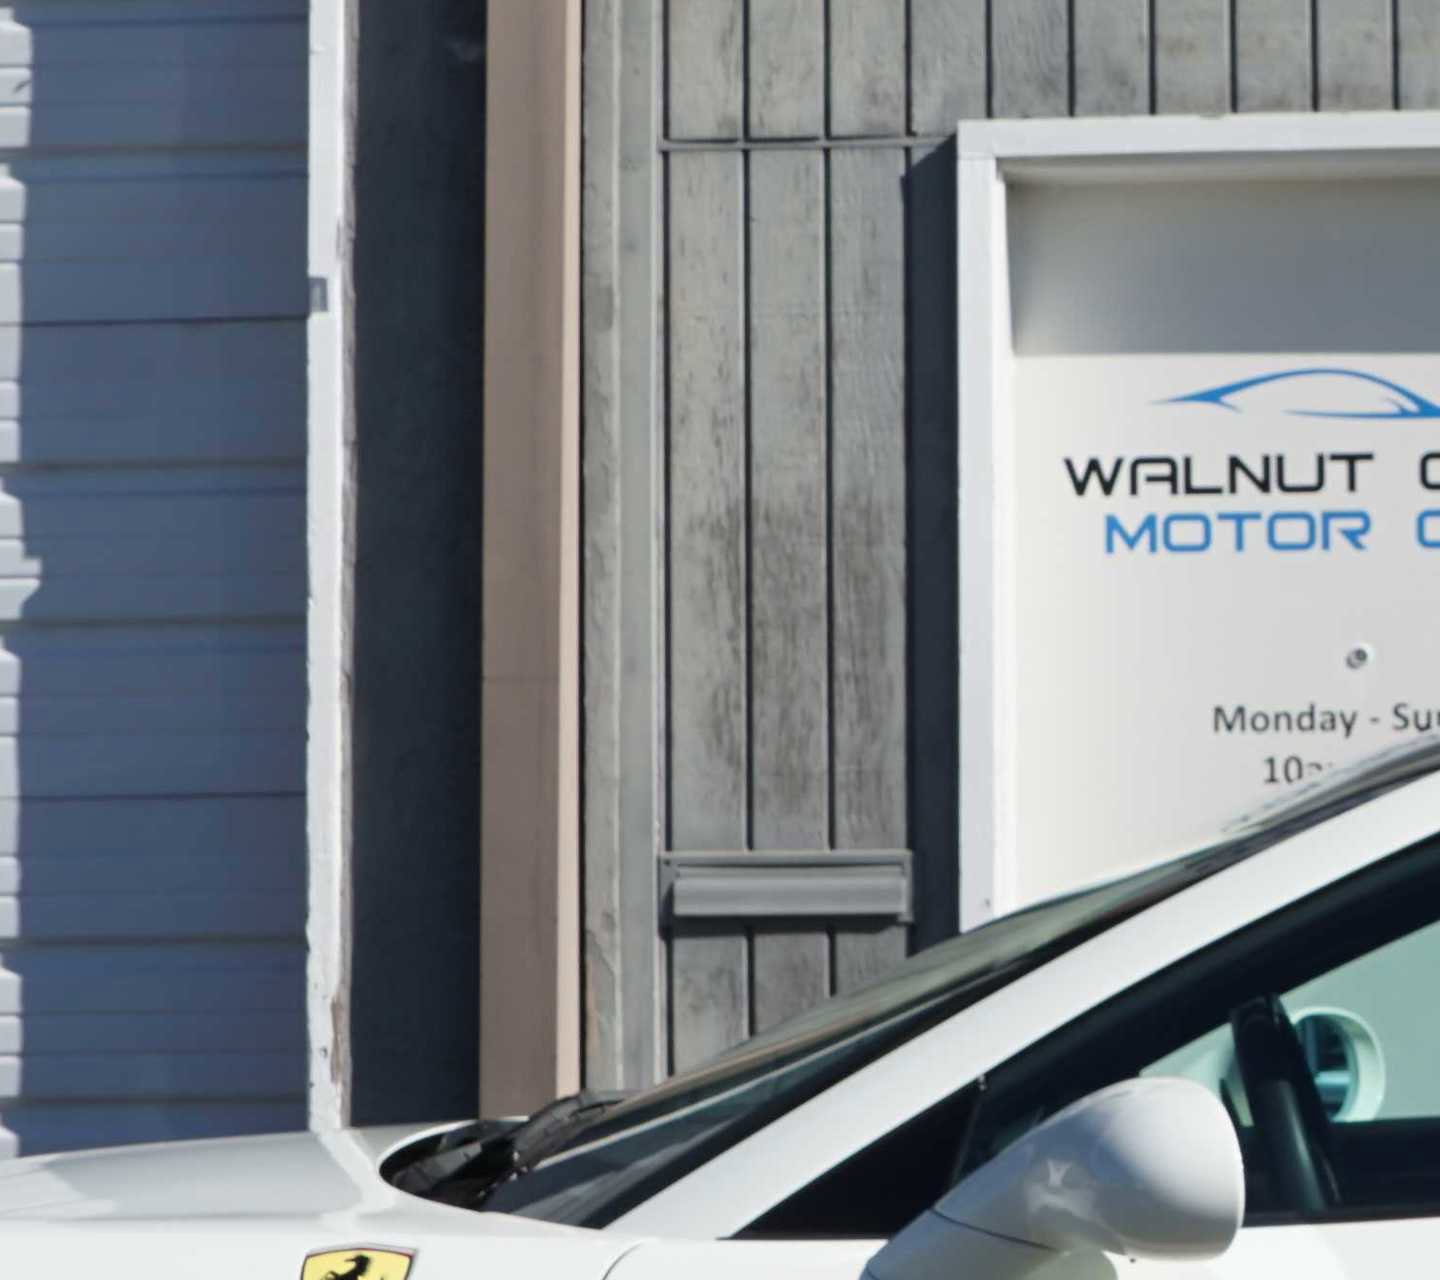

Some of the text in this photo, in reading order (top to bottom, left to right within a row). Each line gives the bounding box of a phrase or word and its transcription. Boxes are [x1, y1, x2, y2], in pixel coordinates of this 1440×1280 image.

[1063, 451, 1375, 497] WALNUT
[1103, 508, 1372, 555] MOTOR
[1212, 698, 1357, 738] Monday
